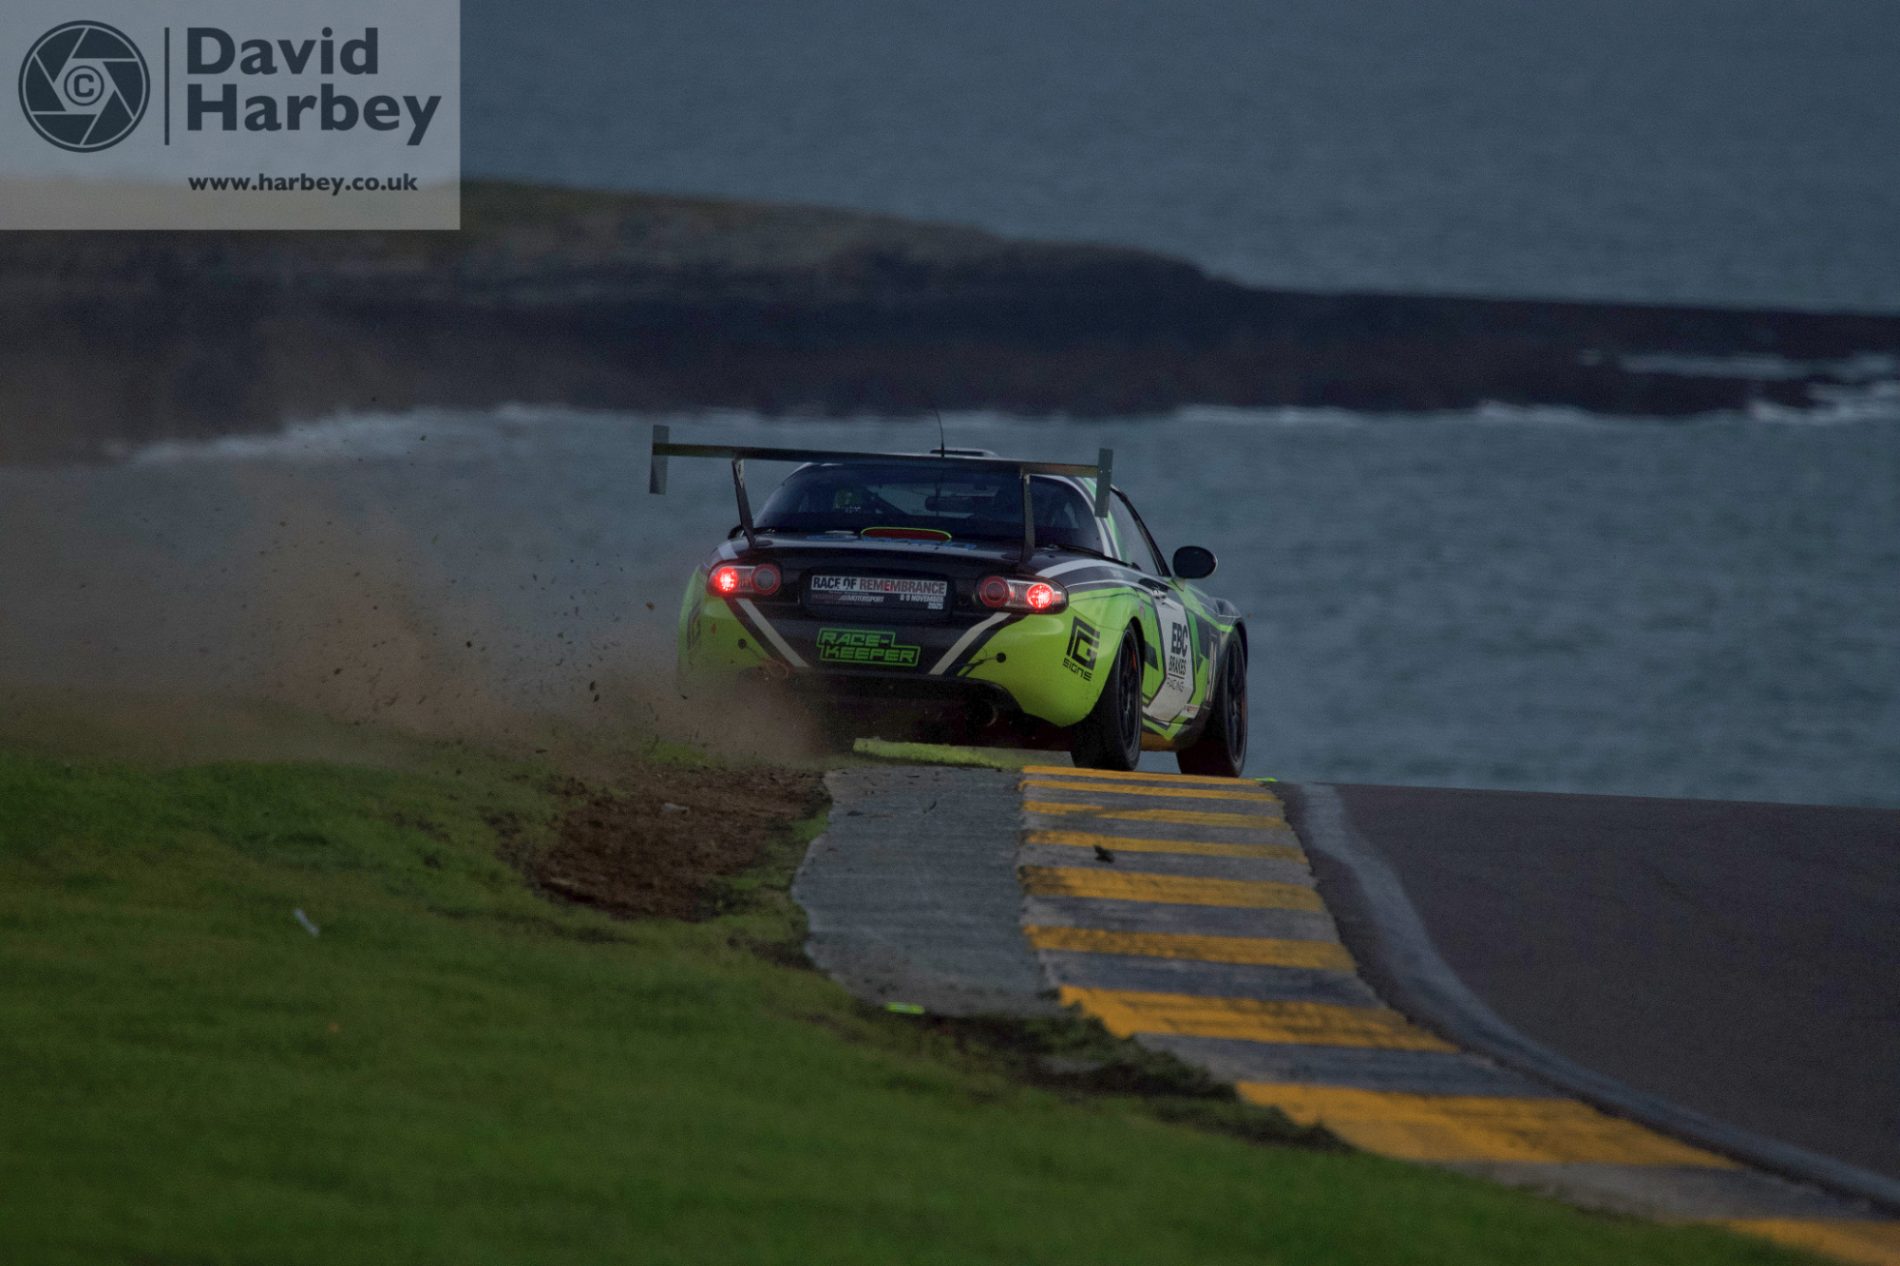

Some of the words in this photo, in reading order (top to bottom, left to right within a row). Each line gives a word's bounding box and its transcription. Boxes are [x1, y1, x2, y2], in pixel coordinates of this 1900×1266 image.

[812, 577, 841, 590] RACE
[843, 577, 857, 589] OF
[859, 578, 946, 595] REMEMBRANCE
[1171, 621, 1188, 657] EBC
[824, 646, 915, 662] KEEPER
[1168, 655, 1187, 676] BRAKES
